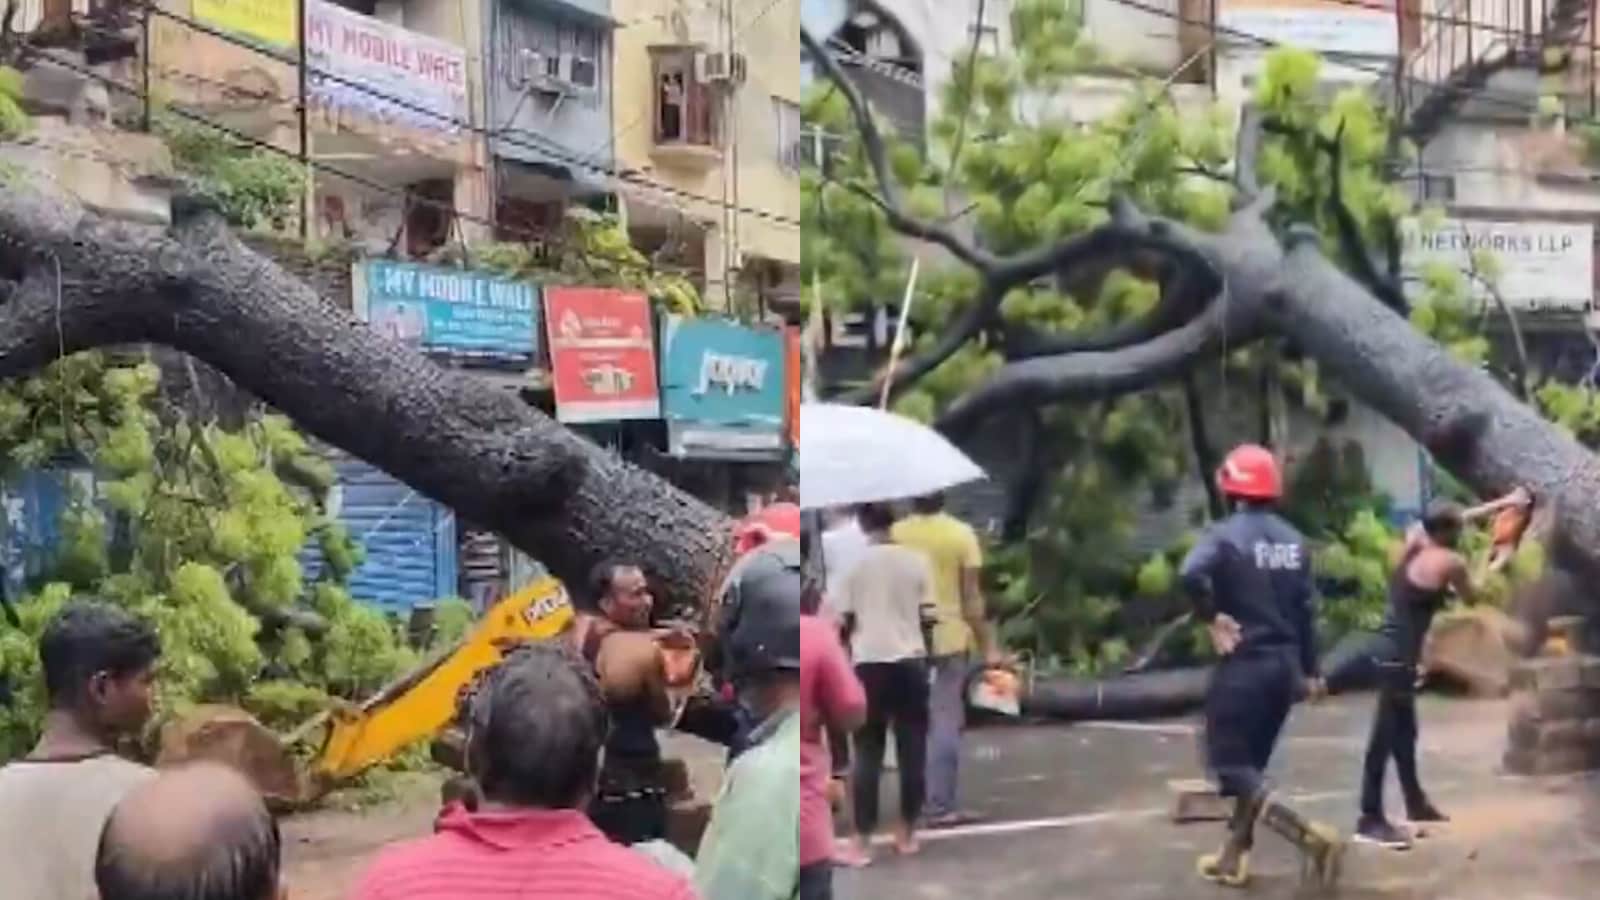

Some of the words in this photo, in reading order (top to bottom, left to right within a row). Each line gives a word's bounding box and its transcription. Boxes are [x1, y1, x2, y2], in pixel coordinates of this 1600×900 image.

[307, 16, 332, 49] MY
[343, 27, 410, 70] MOBILE
[1421, 233, 1532, 253] NETWORKS
[1538, 234, 1573, 252] LLP
[384, 266, 415, 294] MY
[418, 271, 487, 307] MOBILE
[1254, 542, 1302, 570] FIRE
